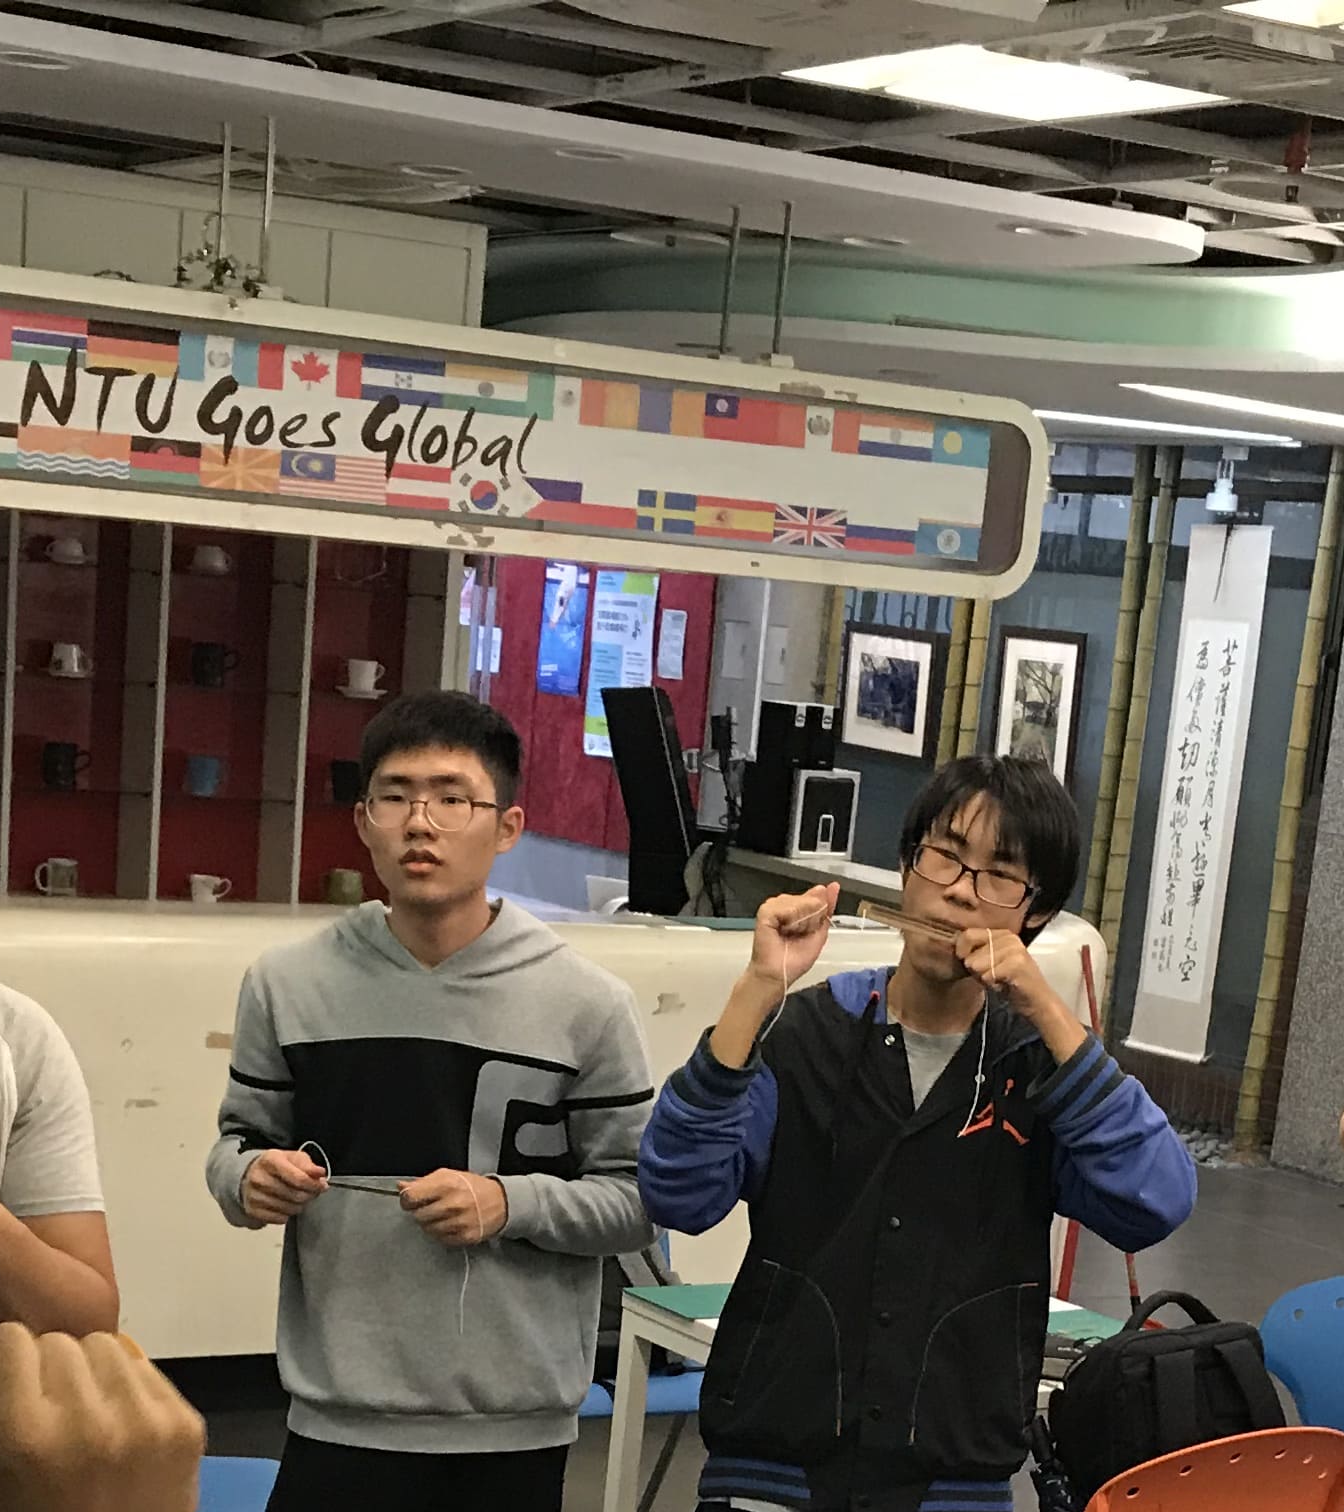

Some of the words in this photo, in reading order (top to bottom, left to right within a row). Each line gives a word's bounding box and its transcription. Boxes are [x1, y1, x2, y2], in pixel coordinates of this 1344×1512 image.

[21, 343, 178, 435] NTU
[197, 376, 342, 465] Goes
[362, 395, 538, 479] Global
